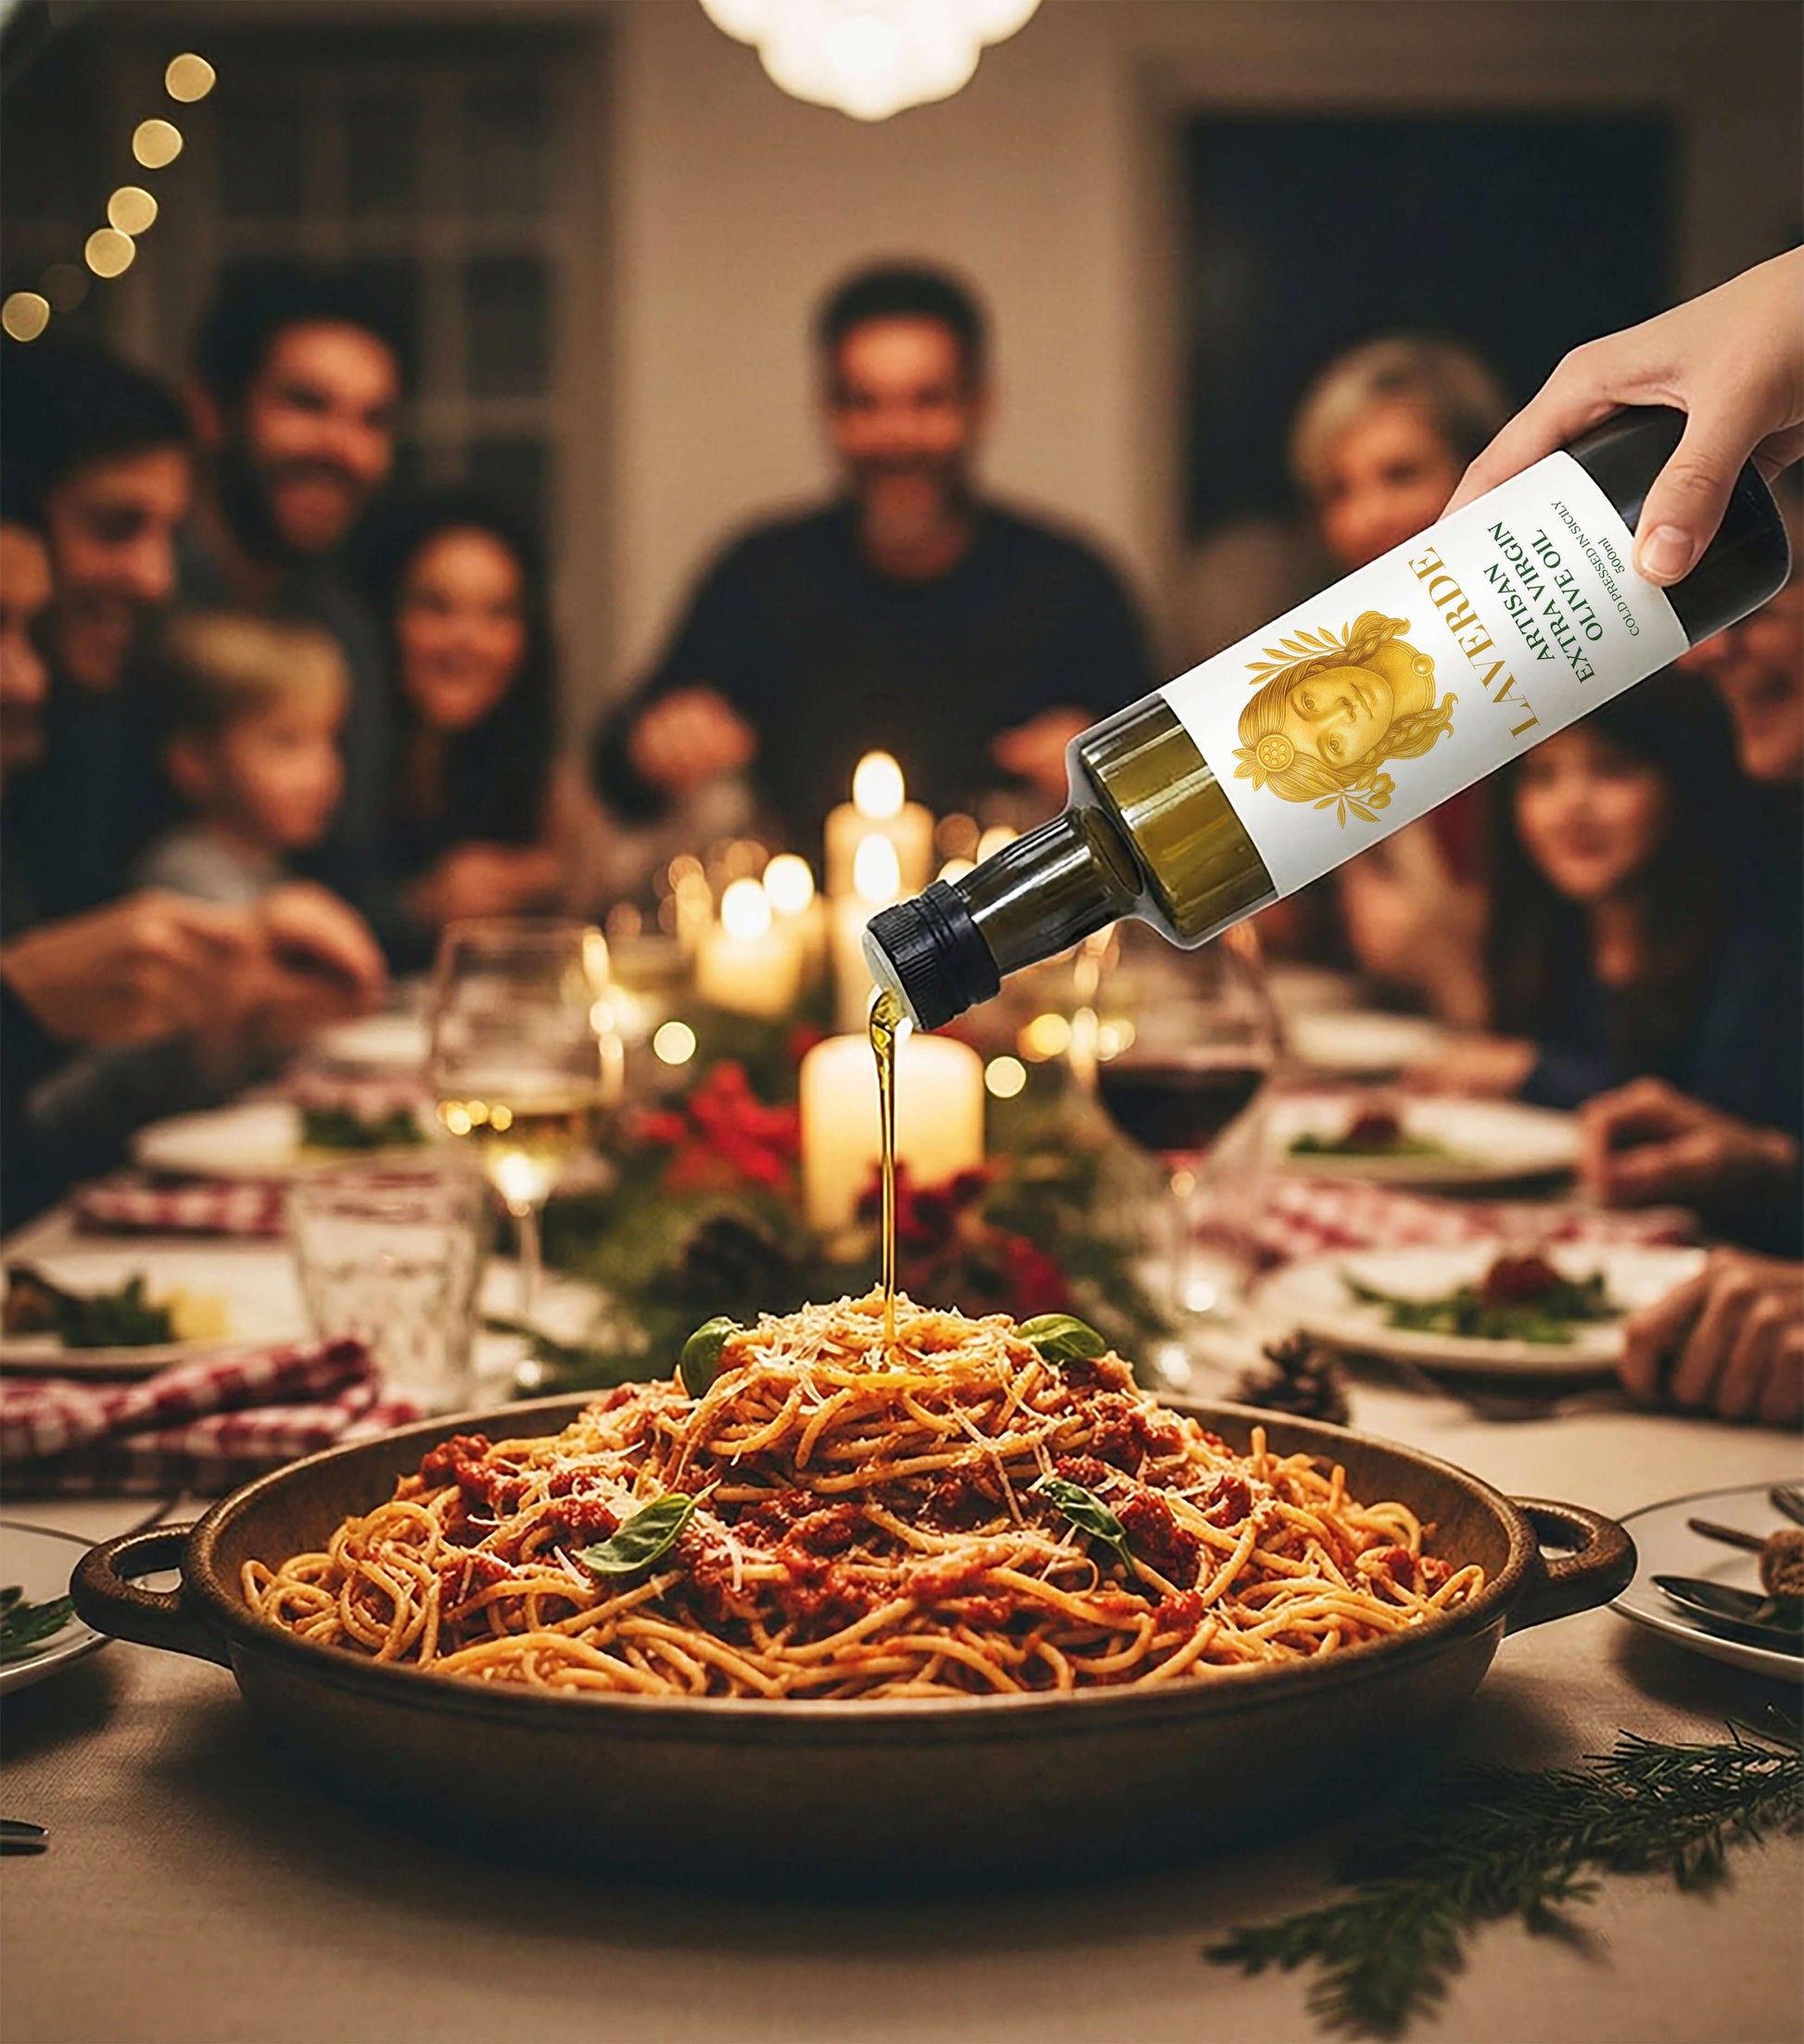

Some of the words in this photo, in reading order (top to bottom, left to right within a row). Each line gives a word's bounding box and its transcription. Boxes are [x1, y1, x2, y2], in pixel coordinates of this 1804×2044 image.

[1551, 501, 1582, 535] SICILY
[1576, 533, 1590, 549] IN
[1487, 521, 1545, 601] VIRGIN
[1531, 528, 1561, 569] OIL
[1585, 548, 1621, 602] PRESSED
[1598, 538, 1625, 574] 500ml
[1483, 563, 1555, 661] ARTISAN
[1554, 568, 1603, 641] OLIVE
[1617, 601, 1640, 637] COLD
[1409, 546, 1541, 740] LAVERDE
[1543, 599, 1595, 684] EXTRA
